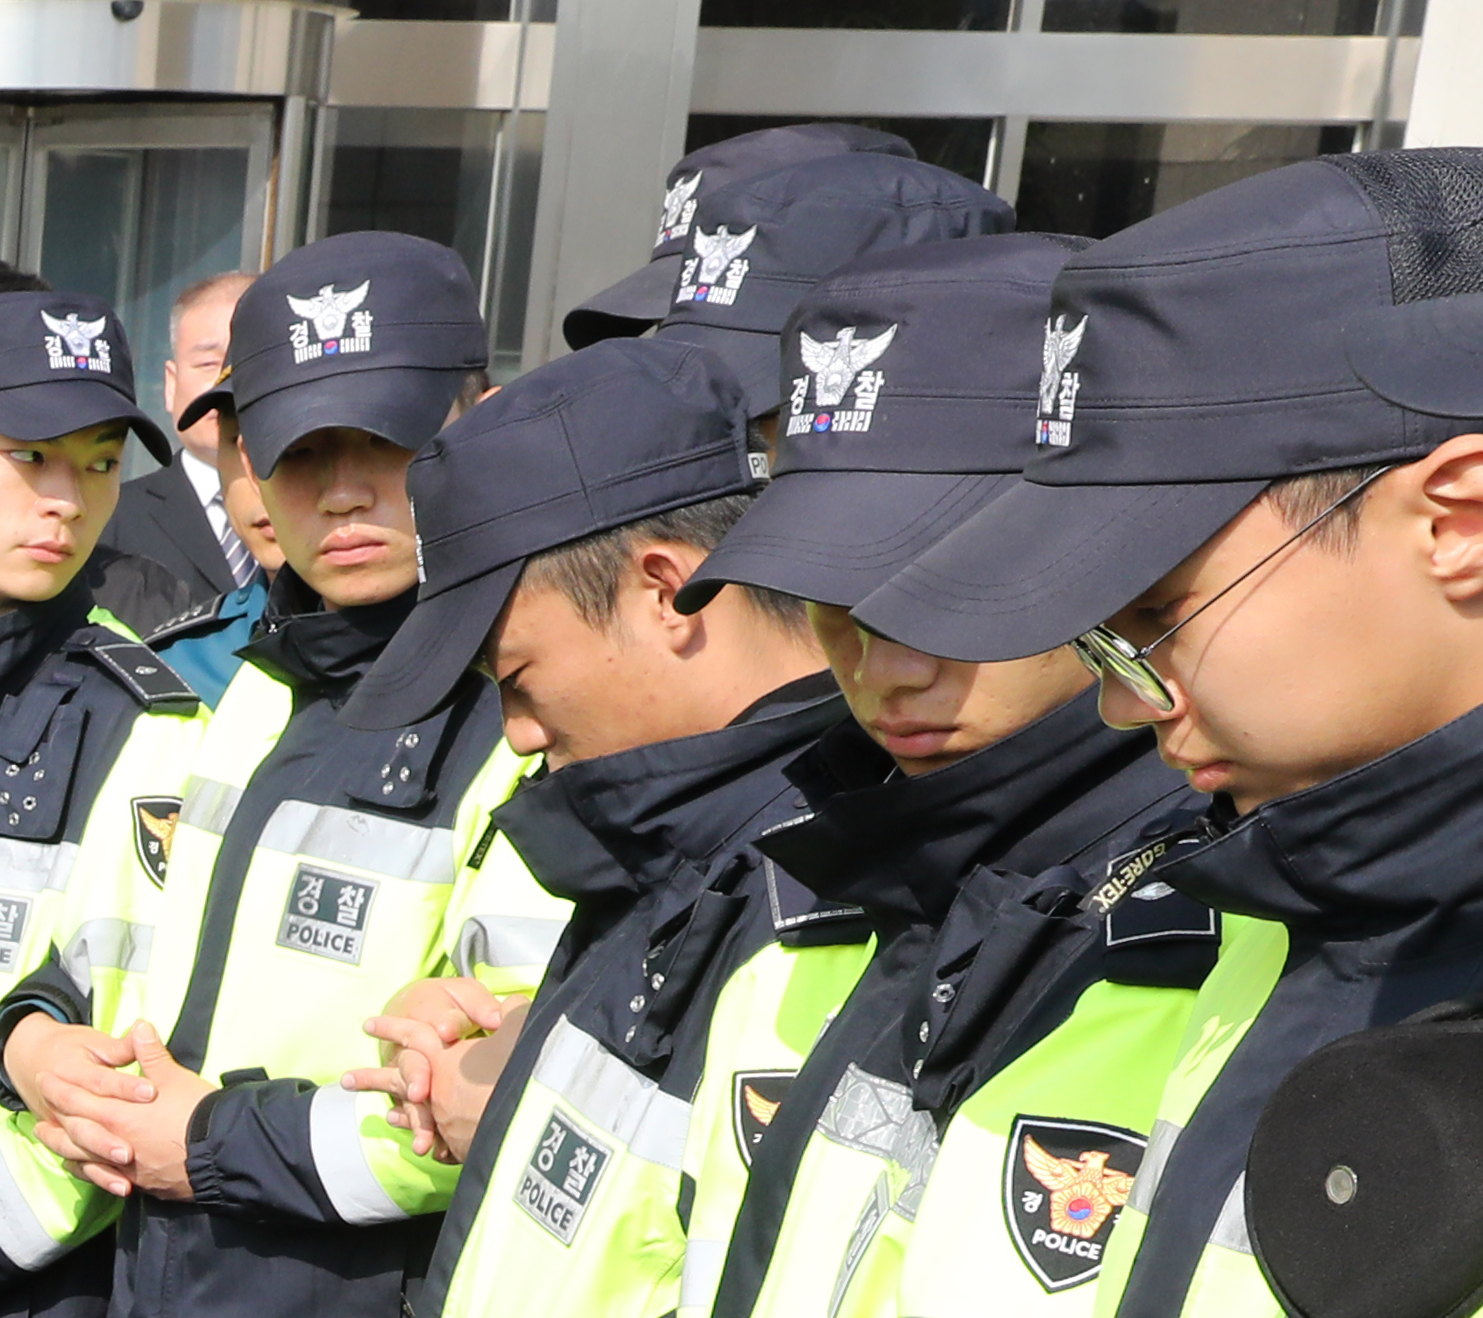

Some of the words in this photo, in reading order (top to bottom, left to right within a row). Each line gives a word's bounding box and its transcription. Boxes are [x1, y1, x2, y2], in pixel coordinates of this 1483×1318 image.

[286, 922, 356, 954] POLICE
[521, 1178, 574, 1231] POLICE
[1032, 1228, 1101, 1261] POLICE
